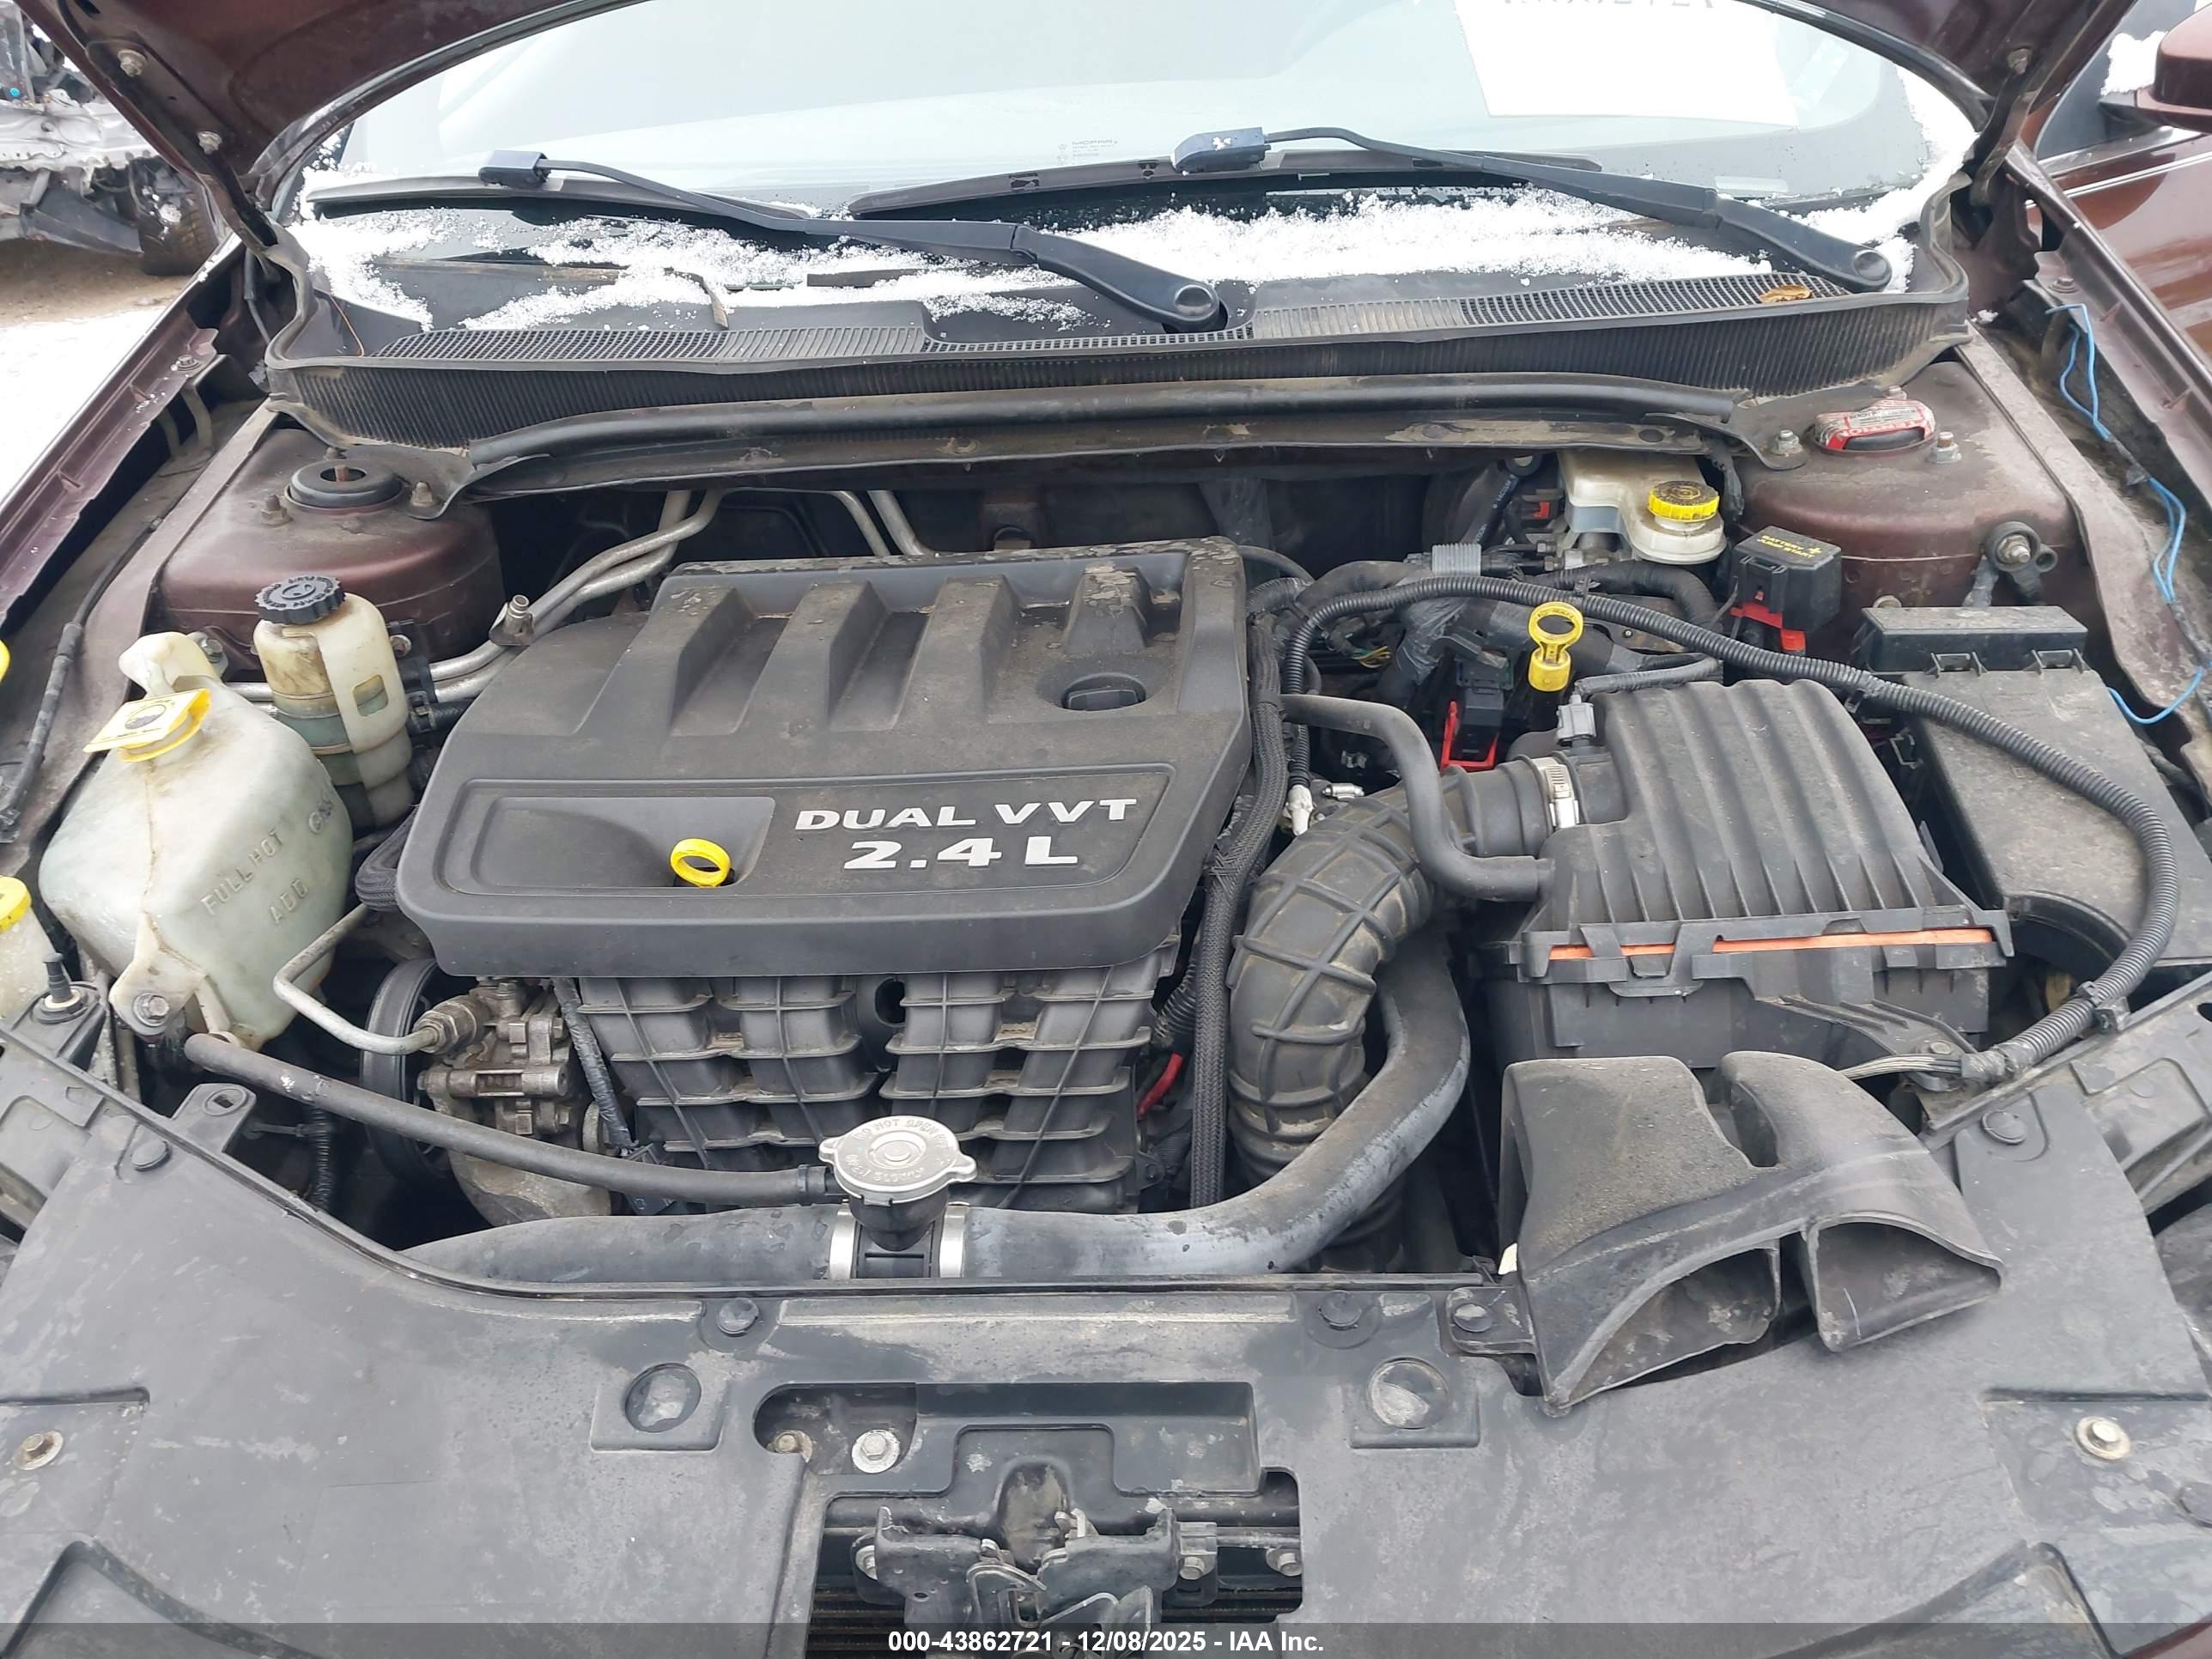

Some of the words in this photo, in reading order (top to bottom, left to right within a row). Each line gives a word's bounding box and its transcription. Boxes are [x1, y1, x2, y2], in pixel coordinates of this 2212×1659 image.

[795, 805, 976, 830] DUAL
[994, 799, 1137, 824] VVT
[844, 837, 1003, 869] 2.4
[1024, 836, 1079, 866] L
[201, 866, 253, 915] FULL
[248, 827, 283, 866] HOT
[270, 878, 309, 924] ADD
[853, 1127, 872, 1141] DO
[872, 1118, 901, 1133] NOT
[905, 1118, 940, 1136] OPEN
